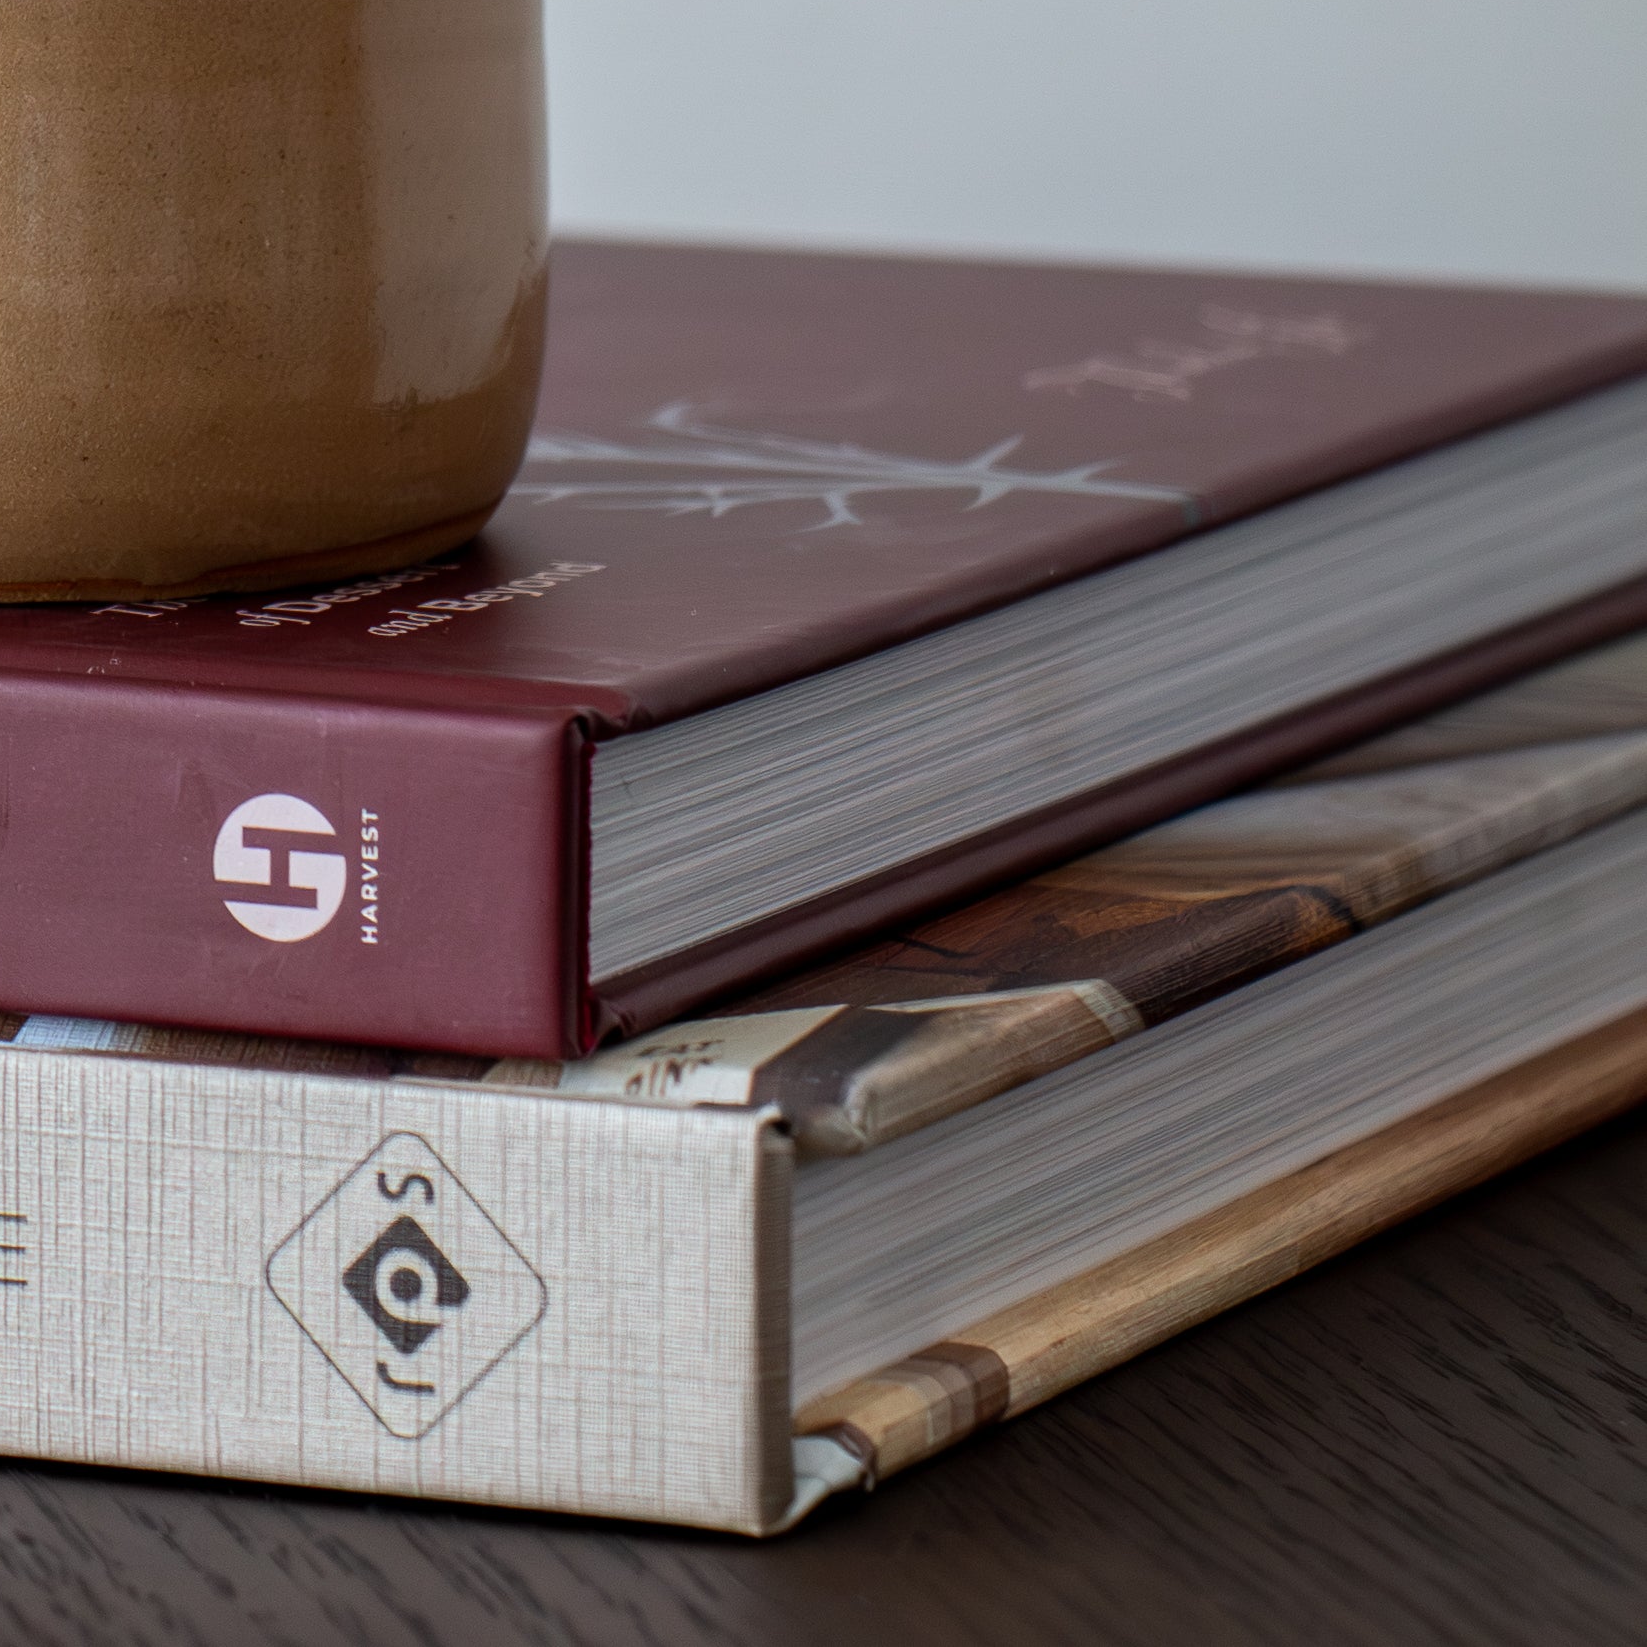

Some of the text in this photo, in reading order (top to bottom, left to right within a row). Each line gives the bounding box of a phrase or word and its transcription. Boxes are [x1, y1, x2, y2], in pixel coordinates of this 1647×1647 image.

[236, 608, 312, 627] of
[367, 560, 608, 637] and Beyond
[360, 808, 380, 944] HARVEST
